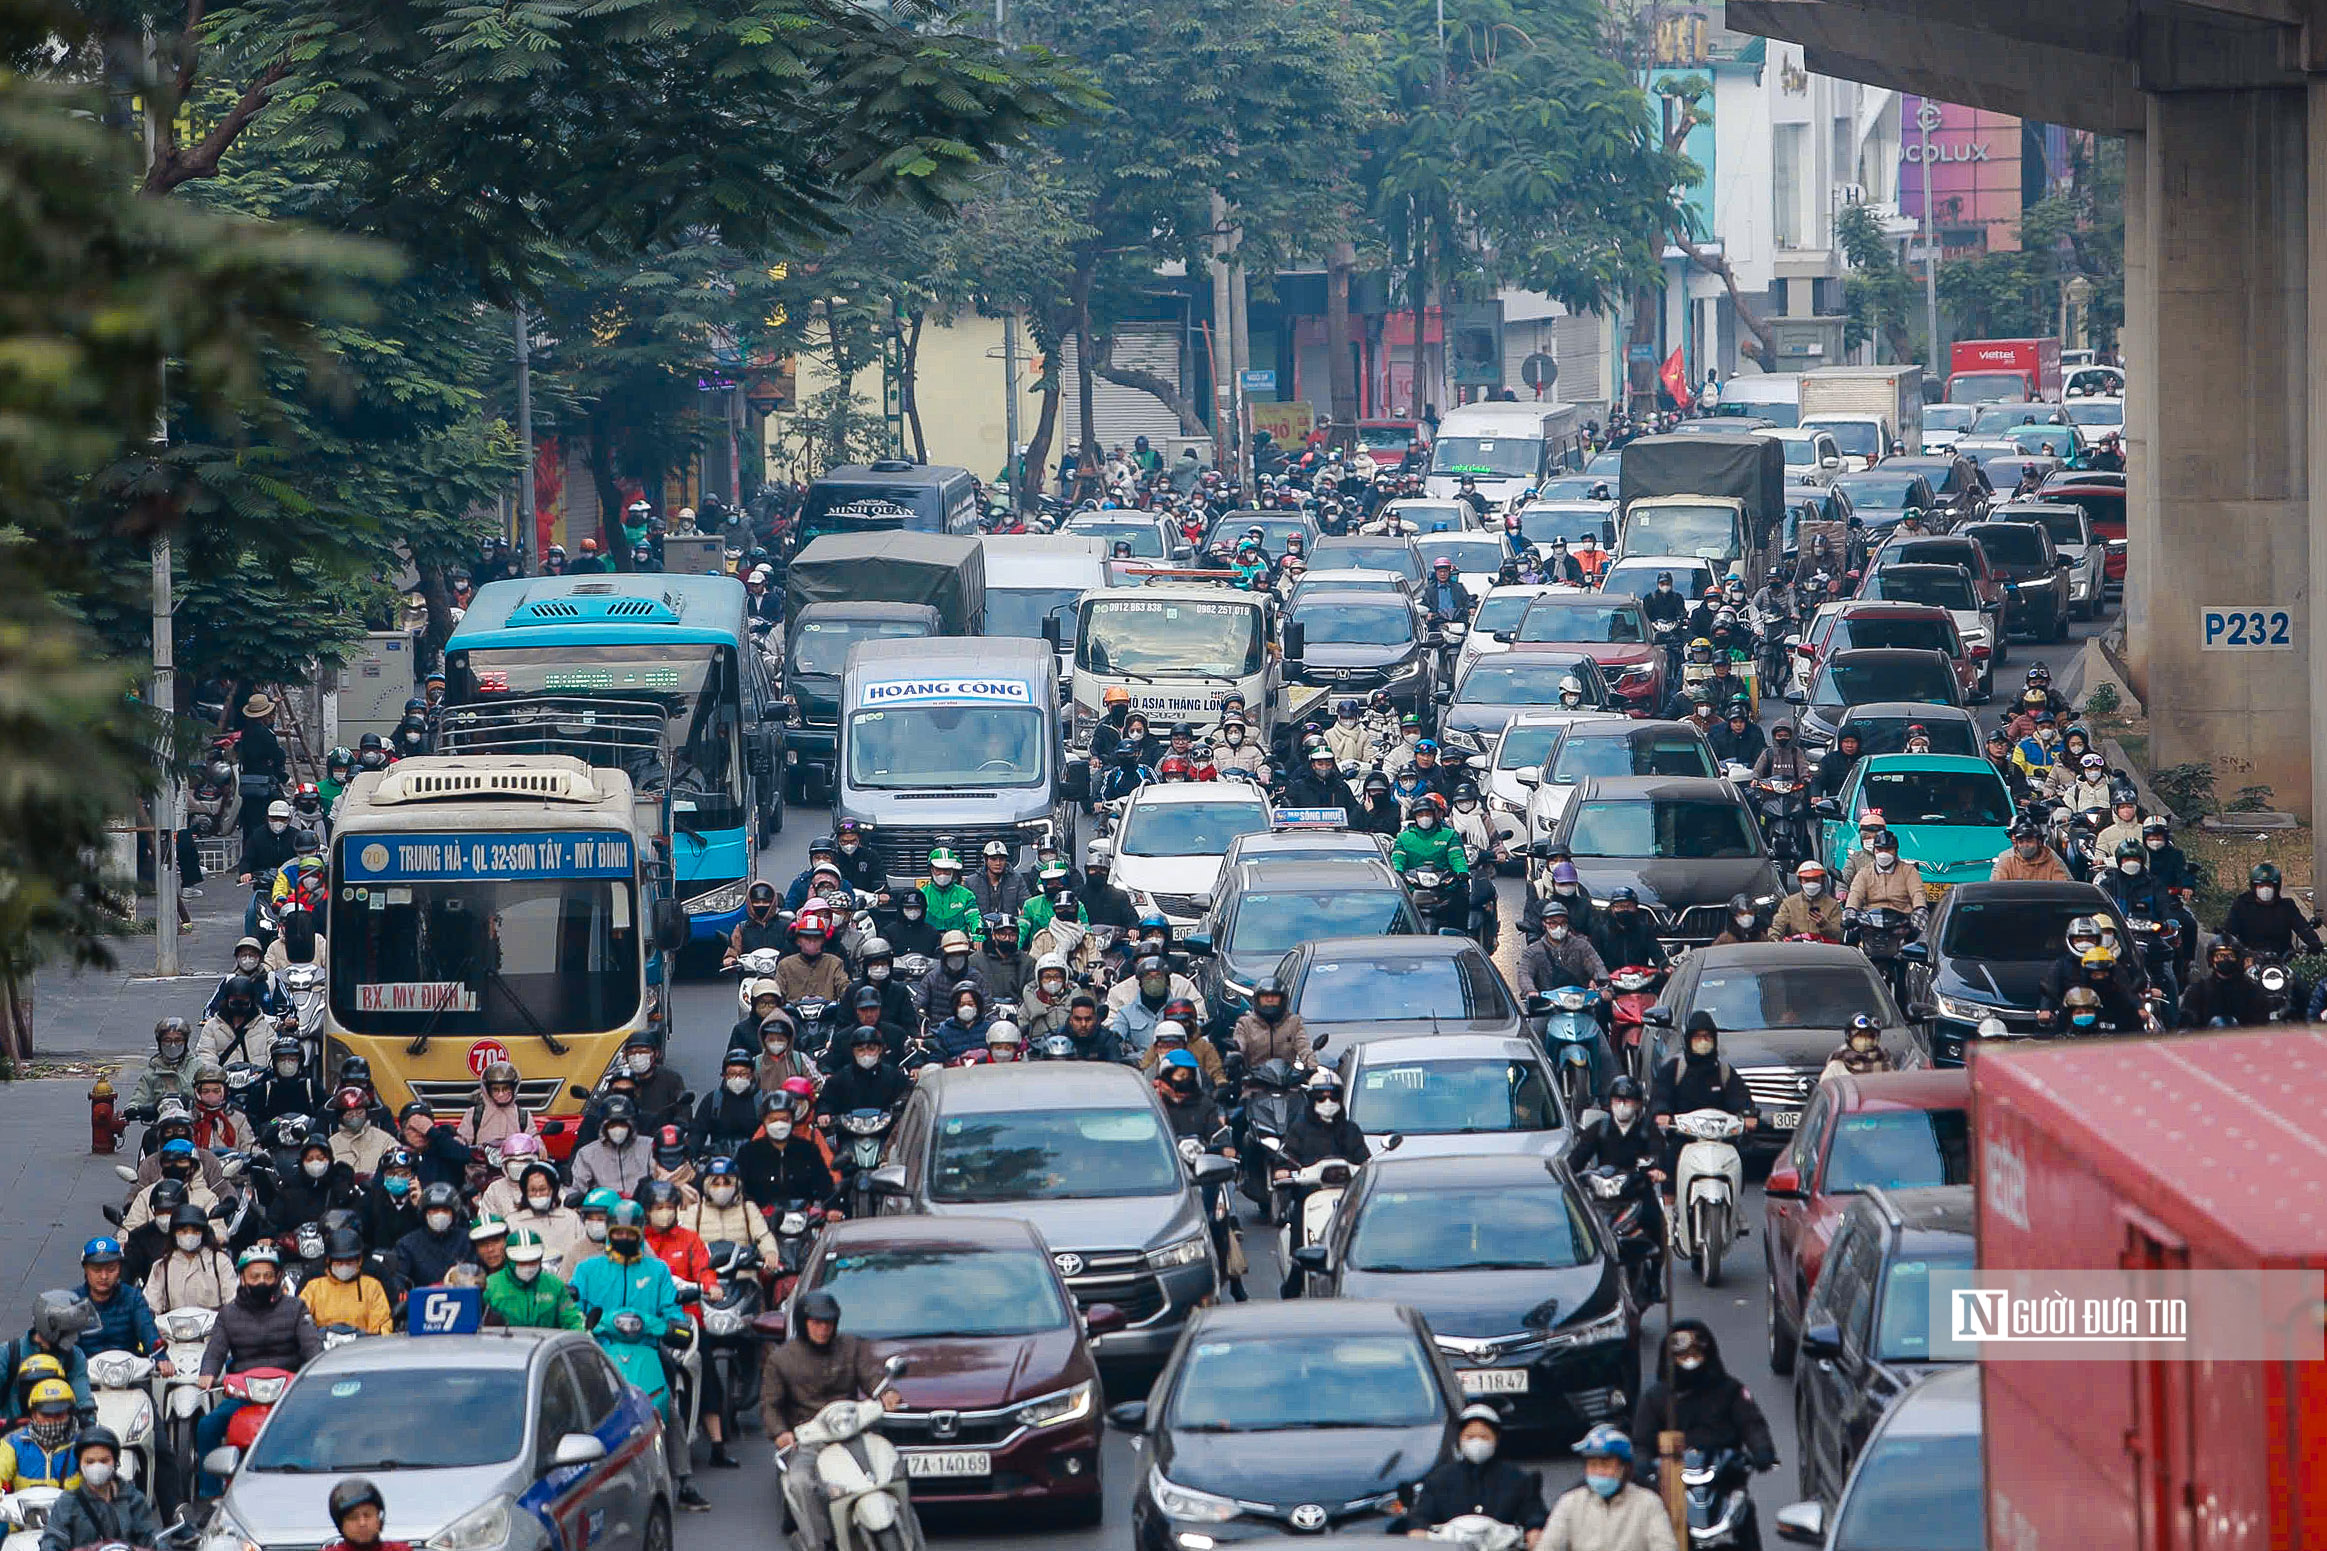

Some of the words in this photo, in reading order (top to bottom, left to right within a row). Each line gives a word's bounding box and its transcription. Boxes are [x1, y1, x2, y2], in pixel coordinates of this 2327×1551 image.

[829, 506, 867, 514] MINH
[2205, 612, 2290, 645] P232
[1141, 697, 1165, 709] ASIA
[398, 845, 441, 872] TRUNG
[472, 846, 488, 874] QL
[538, 837, 562, 870] TÂY
[574, 837, 595, 868] MỸ
[599, 837, 628, 868] ĐÌNH
[425, 1293, 461, 1332] G7
